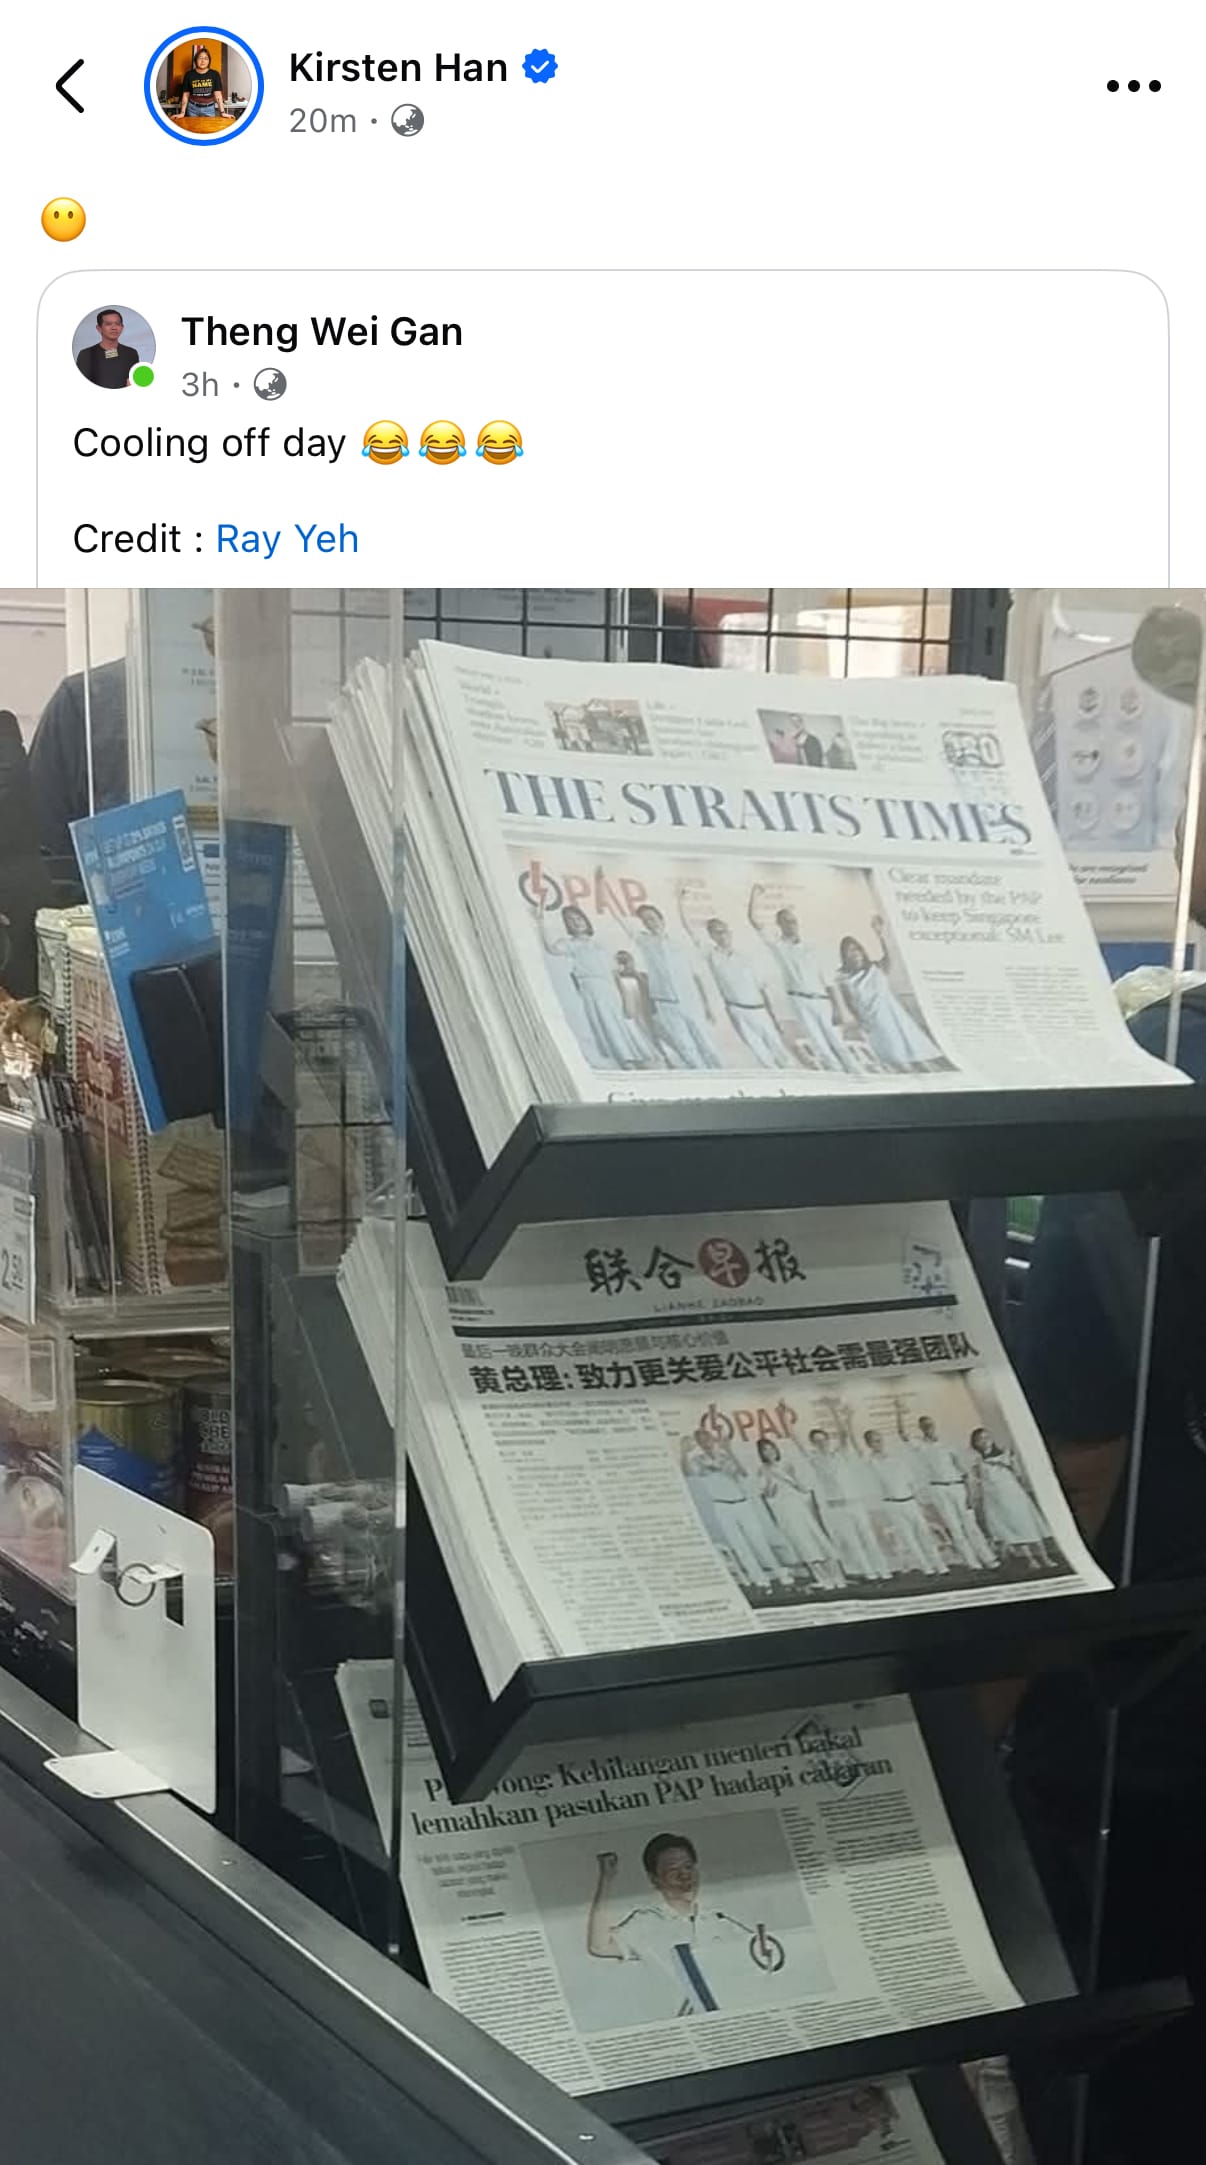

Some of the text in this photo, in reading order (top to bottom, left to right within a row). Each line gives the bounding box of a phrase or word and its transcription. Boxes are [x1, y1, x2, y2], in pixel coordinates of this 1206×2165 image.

[484, 768, 1034, 846] THE STRAITS TIMES
[889, 867, 929, 884] Clear
[585, 1237, 806, 1296] 联合早报
[557, 1751, 699, 1788] Kehilangan
[703, 1739, 793, 1768] menteri
[797, 1726, 864, 1754] bakal
[411, 1804, 539, 1836] lemahkan
[545, 1789, 650, 1828] pasukan
[653, 1775, 705, 1805] PAP
[709, 1766, 795, 1797] hadapi
